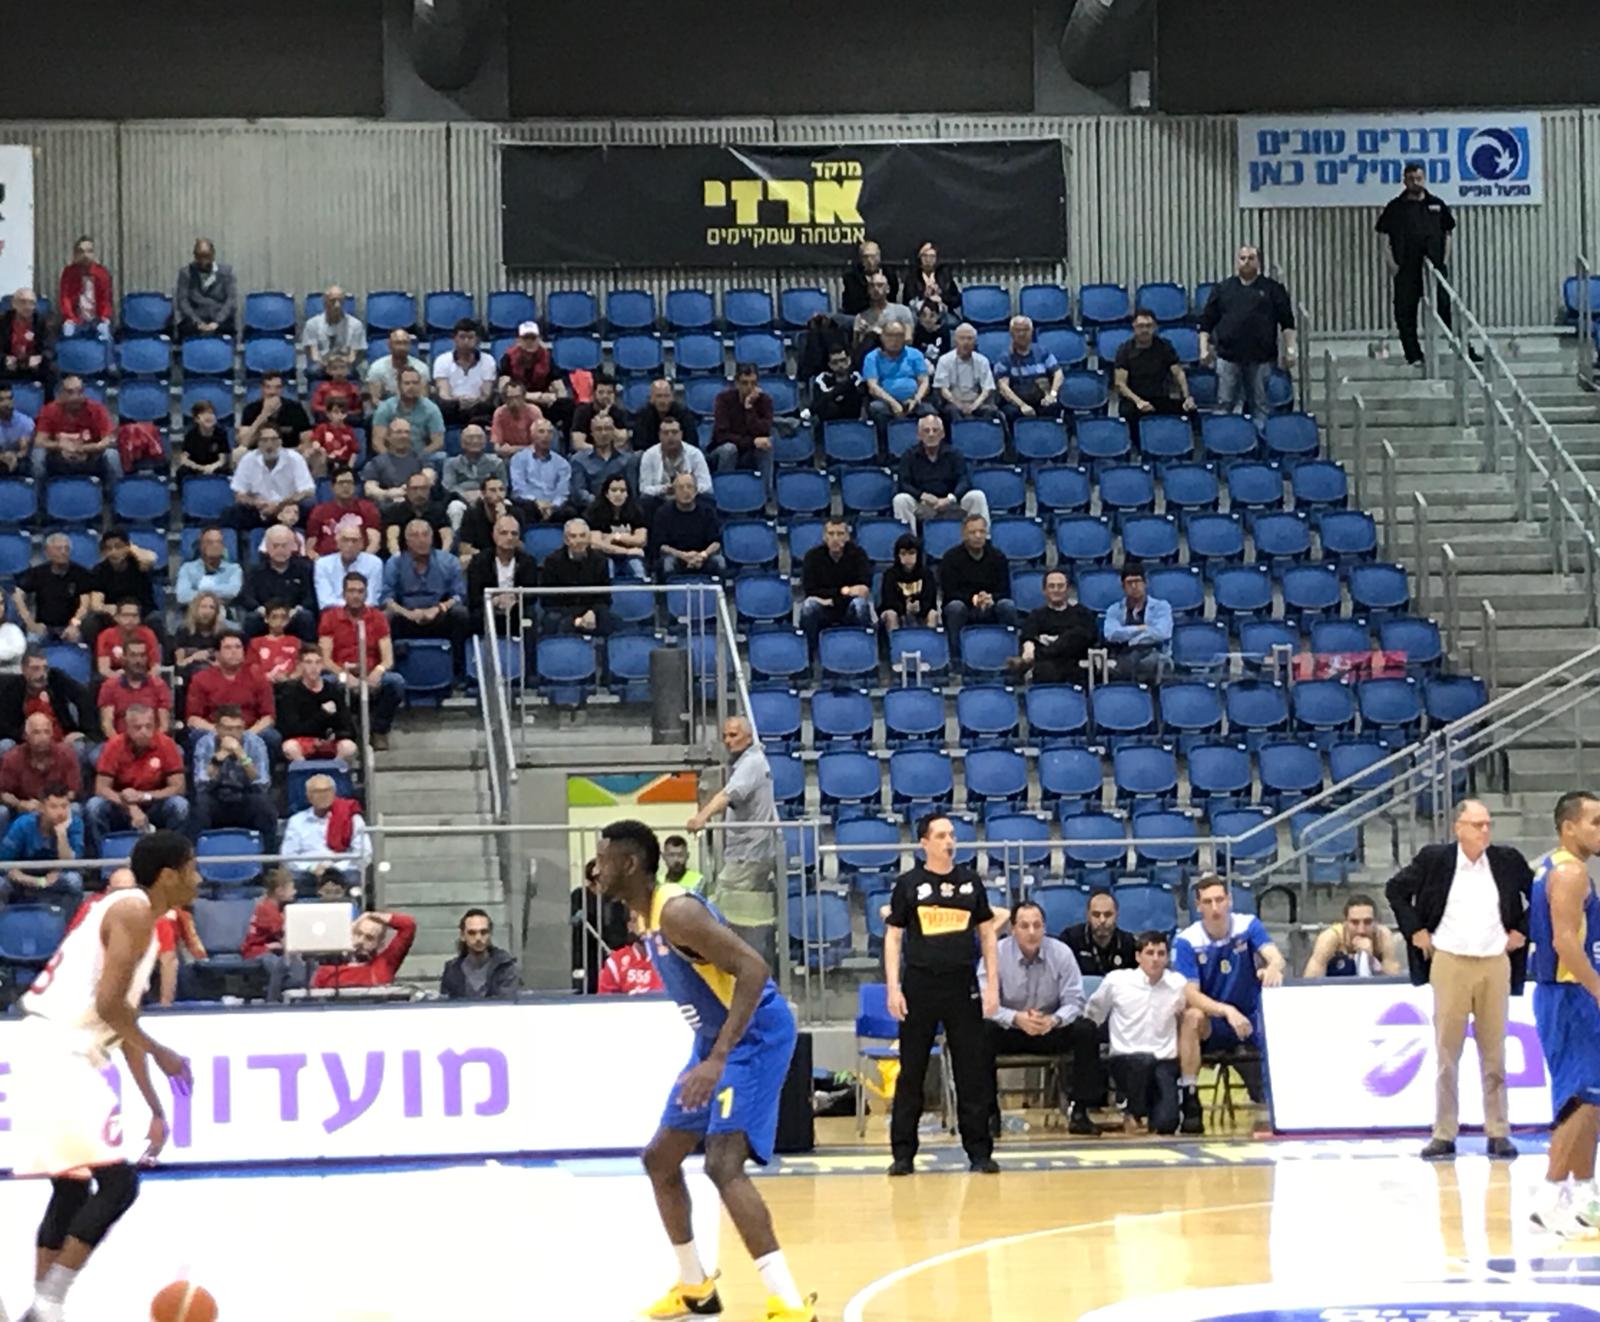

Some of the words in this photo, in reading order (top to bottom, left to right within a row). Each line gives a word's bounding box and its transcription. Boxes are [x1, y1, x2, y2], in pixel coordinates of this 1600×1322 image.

[1257, 128, 1346, 156] טובים
[1357, 127, 1449, 155] דברים
[810, 160, 862, 180] מוקד
[1248, 159, 1305, 193] כאן
[703, 179, 865, 225] ארזי
[706, 227, 796, 249] שמקיימים
[800, 226, 866, 246] אבטחה
[168, 1046, 512, 1149] מועדון
[716, 1087, 734, 1119] 1
